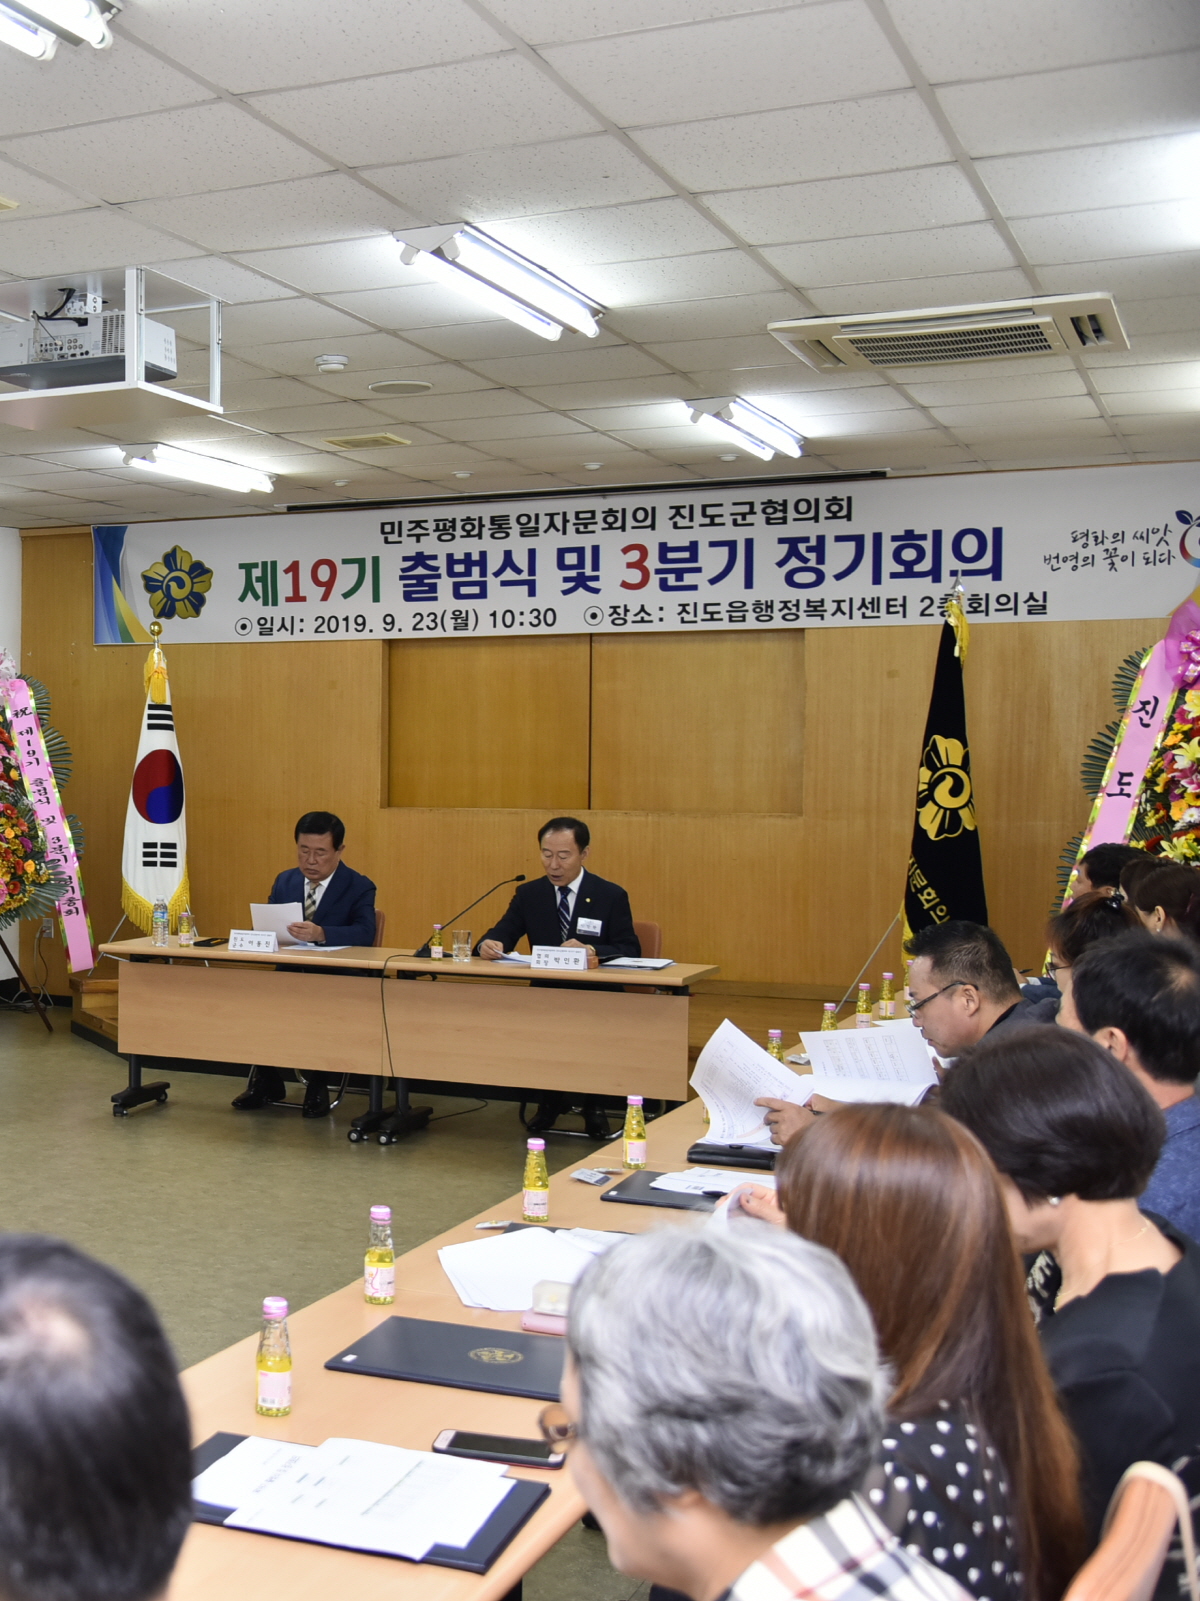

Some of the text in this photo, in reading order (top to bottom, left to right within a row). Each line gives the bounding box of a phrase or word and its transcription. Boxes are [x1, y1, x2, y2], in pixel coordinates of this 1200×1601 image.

[380, 496, 853, 545] 민주평화통일자문회의 진도군협의회
[1071, 523, 1173, 549] 평화의 씨앗
[238, 526, 1003, 607] 제19기 출범식 및 3분기 정기회의
[1043, 547, 1176, 572] 번영의 꽃이 되다
[314, 614, 374, 634] 2019.
[383, 613, 403, 633] 9.
[412, 608, 479, 633] 23(월)
[489, 607, 557, 630] 10:30
[676, 595, 908, 625] 진도읍행정복지센터
